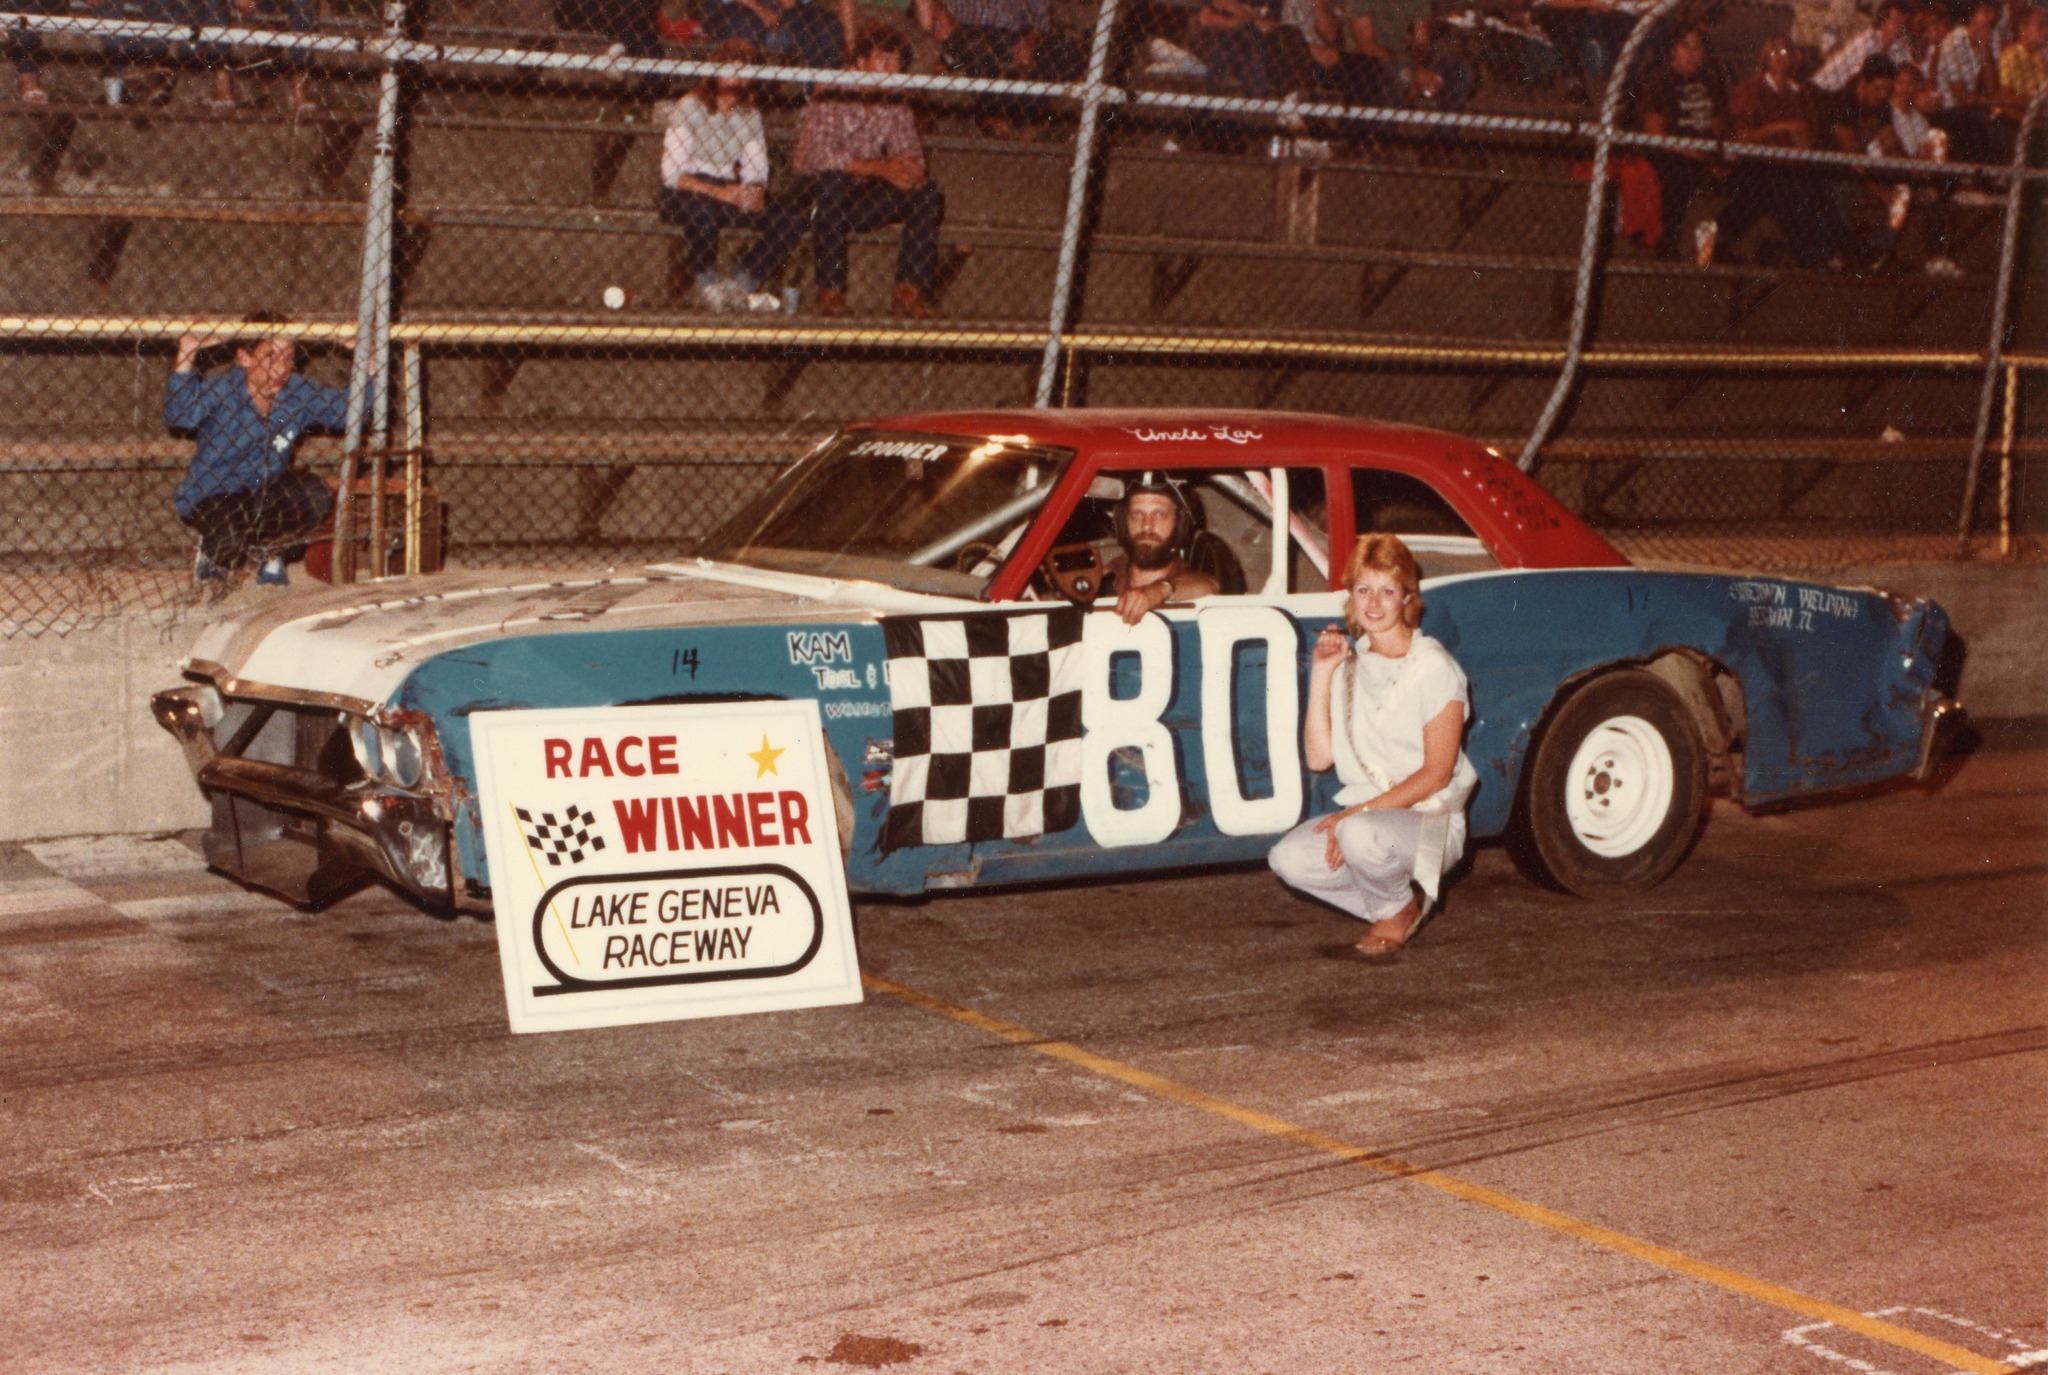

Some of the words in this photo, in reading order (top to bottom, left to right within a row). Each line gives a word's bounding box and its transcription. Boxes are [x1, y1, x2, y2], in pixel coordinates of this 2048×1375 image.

[849, 441, 948, 461] SPOONER
[1121, 427, 1207, 441] Uncle
[673, 648, 702, 681] 14
[787, 630, 852, 665] KAM
[811, 666, 861, 690] TOOL
[1080, 605, 1306, 848] 80
[544, 735, 680, 779] RACE
[613, 790, 812, 854] WINNER
[570, 892, 649, 929] LAKE
[658, 884, 781, 922] GENEVA
[603, 926, 753, 969] RACEWAY
